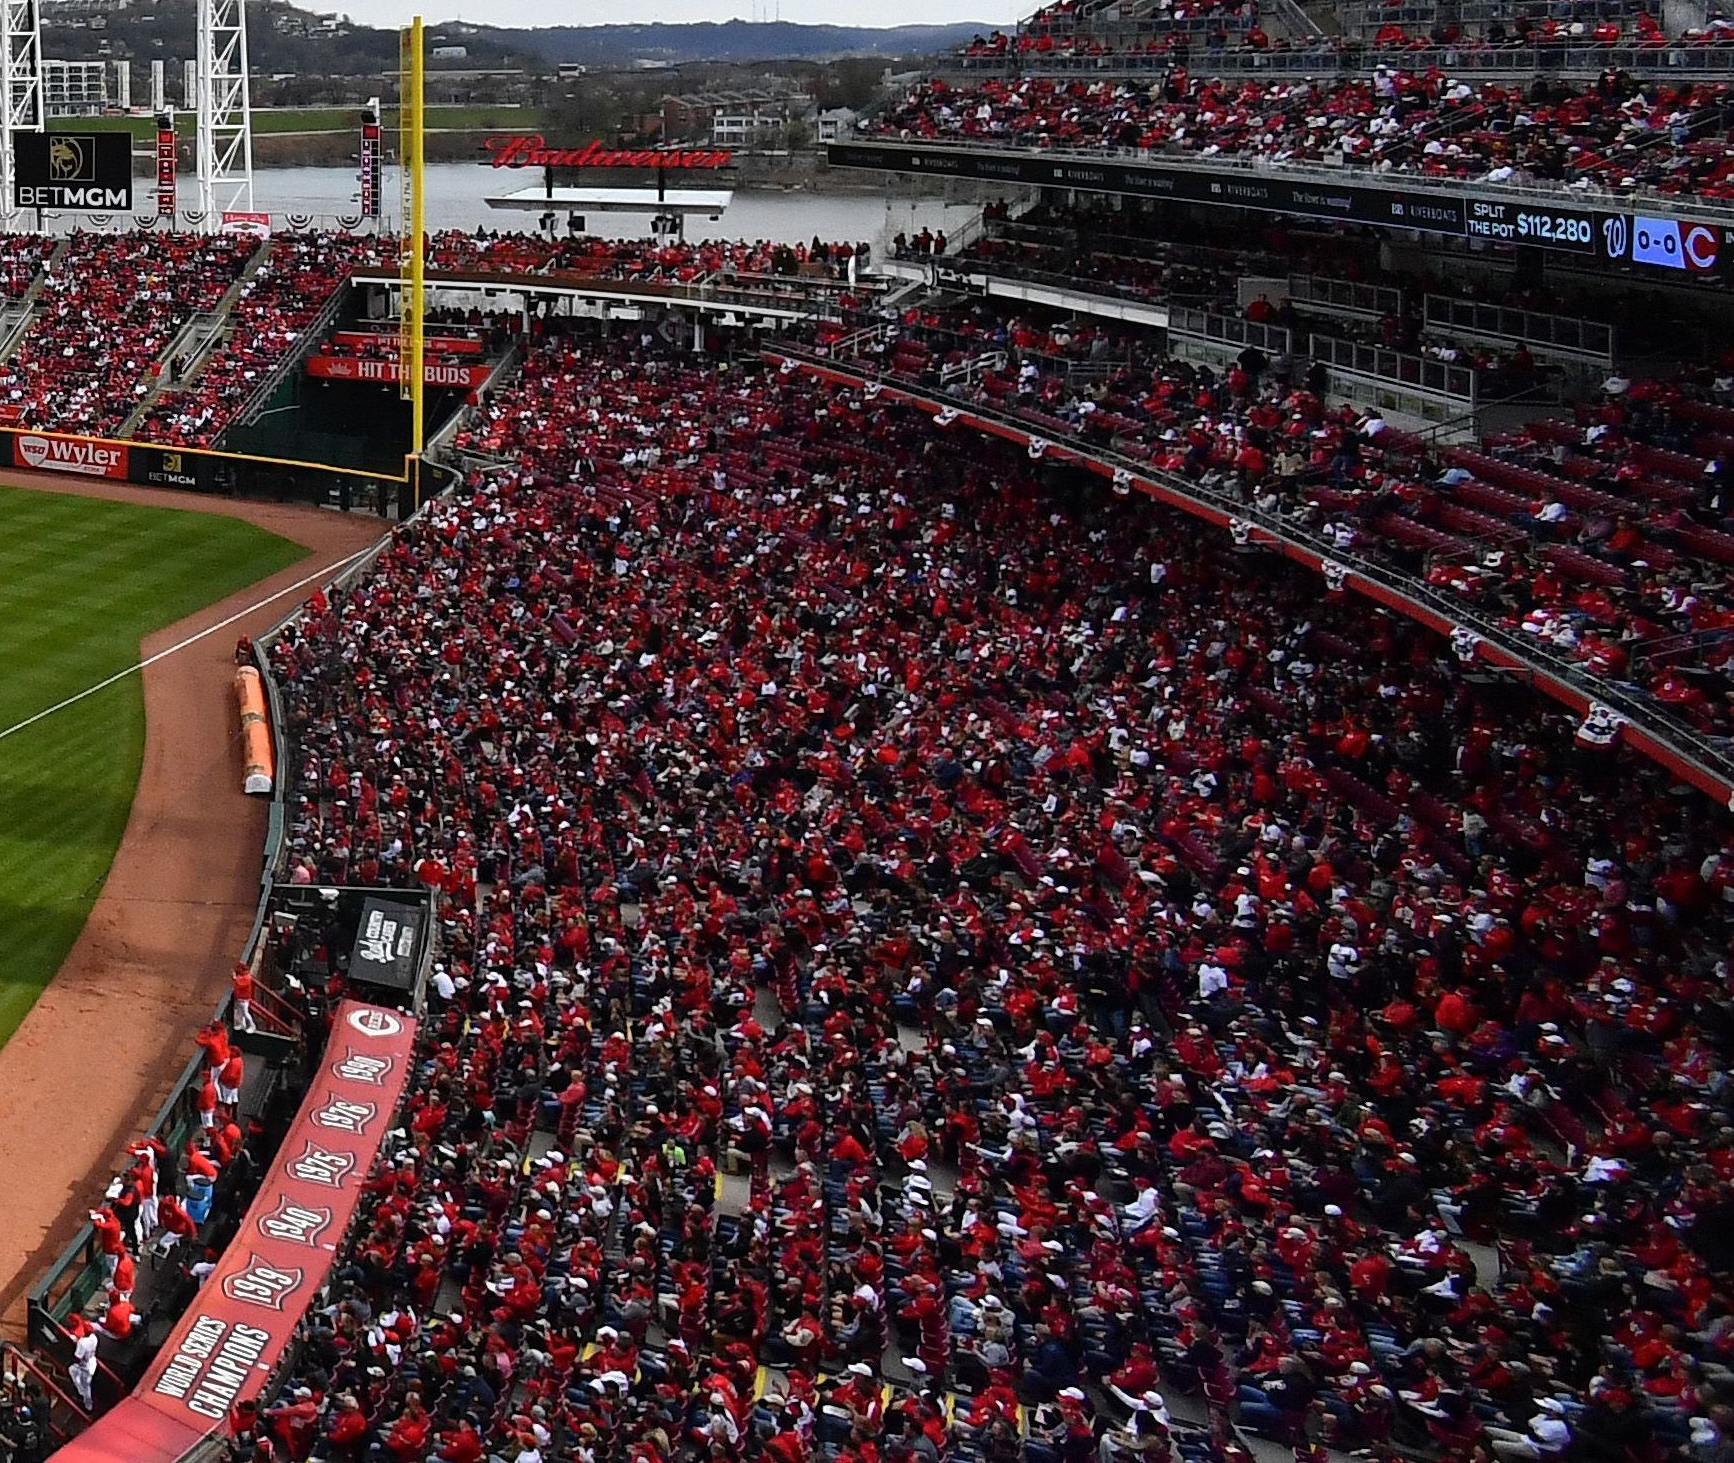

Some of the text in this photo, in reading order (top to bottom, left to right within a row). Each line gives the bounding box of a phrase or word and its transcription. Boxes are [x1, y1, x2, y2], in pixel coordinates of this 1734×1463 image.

[485, 136, 732, 168] Budweiser
[19, 187, 126, 207] BETMGM
[1473, 203, 1505, 218] SPLIT
[1468, 220, 1515, 237] THE POT
[1517, 213, 1591, 243] $112,280
[358, 362, 470, 384] HIT BUDS
[50, 440, 121, 468] Wyler
[149, 472, 196, 485] BETMGM
[339, 1055, 388, 1082] 1990
[319, 1101, 370, 1130] 1976
[294, 1151, 348, 1183] 1975
[266, 1206, 323, 1242] 1940
[232, 1267, 292, 1304] 1919
[154, 1314, 227, 1399] WORLD SERIES
[187, 1322, 270, 1420] CHAMPIONS
